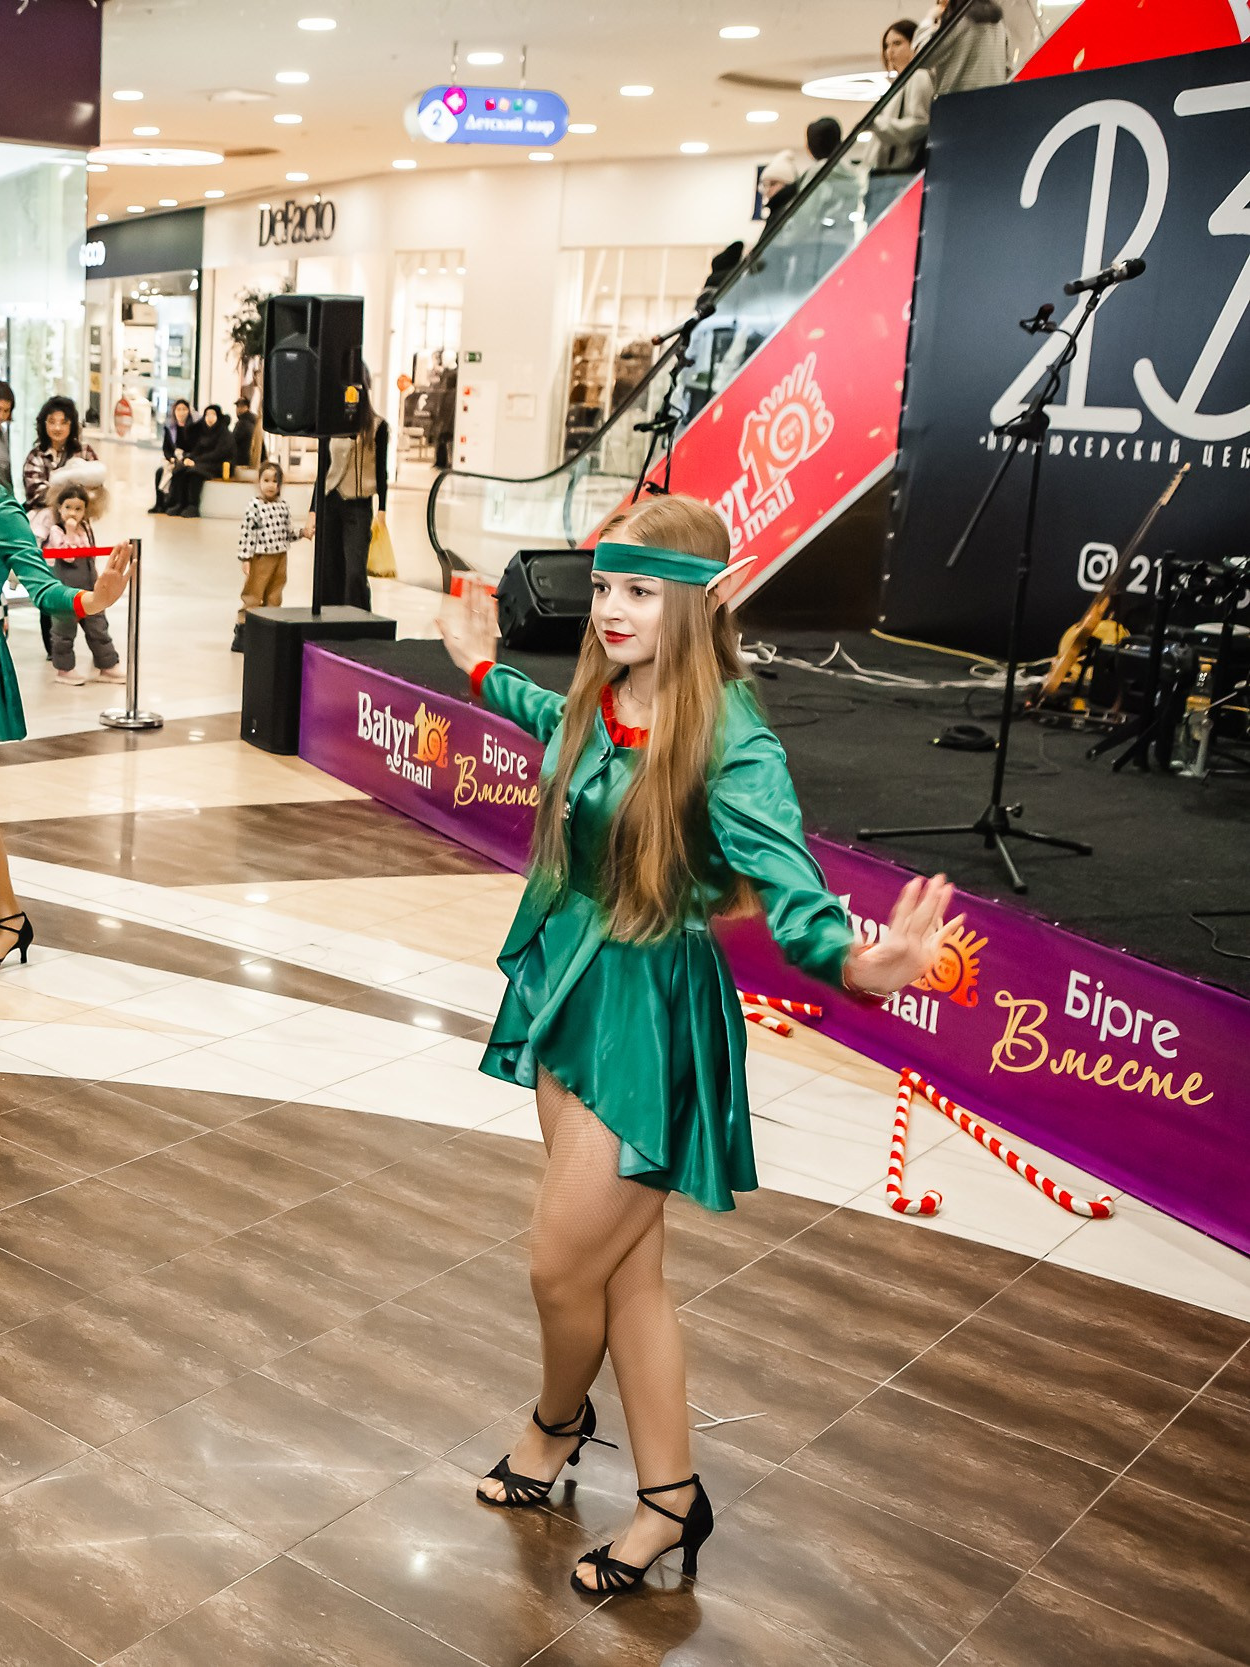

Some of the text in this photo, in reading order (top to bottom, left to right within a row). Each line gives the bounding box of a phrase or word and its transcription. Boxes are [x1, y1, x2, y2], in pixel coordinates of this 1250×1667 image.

[432, 108, 443, 127] 2
[743, 478, 795, 543] mall
[357, 691, 415, 775] Batyr
[482, 732, 528, 781] Бірге
[402, 759, 433, 790] mall
[453, 752, 540, 809] Вместе
[1064, 969, 1181, 1059] Бірге
[989, 989, 1215, 1106] Вместе
